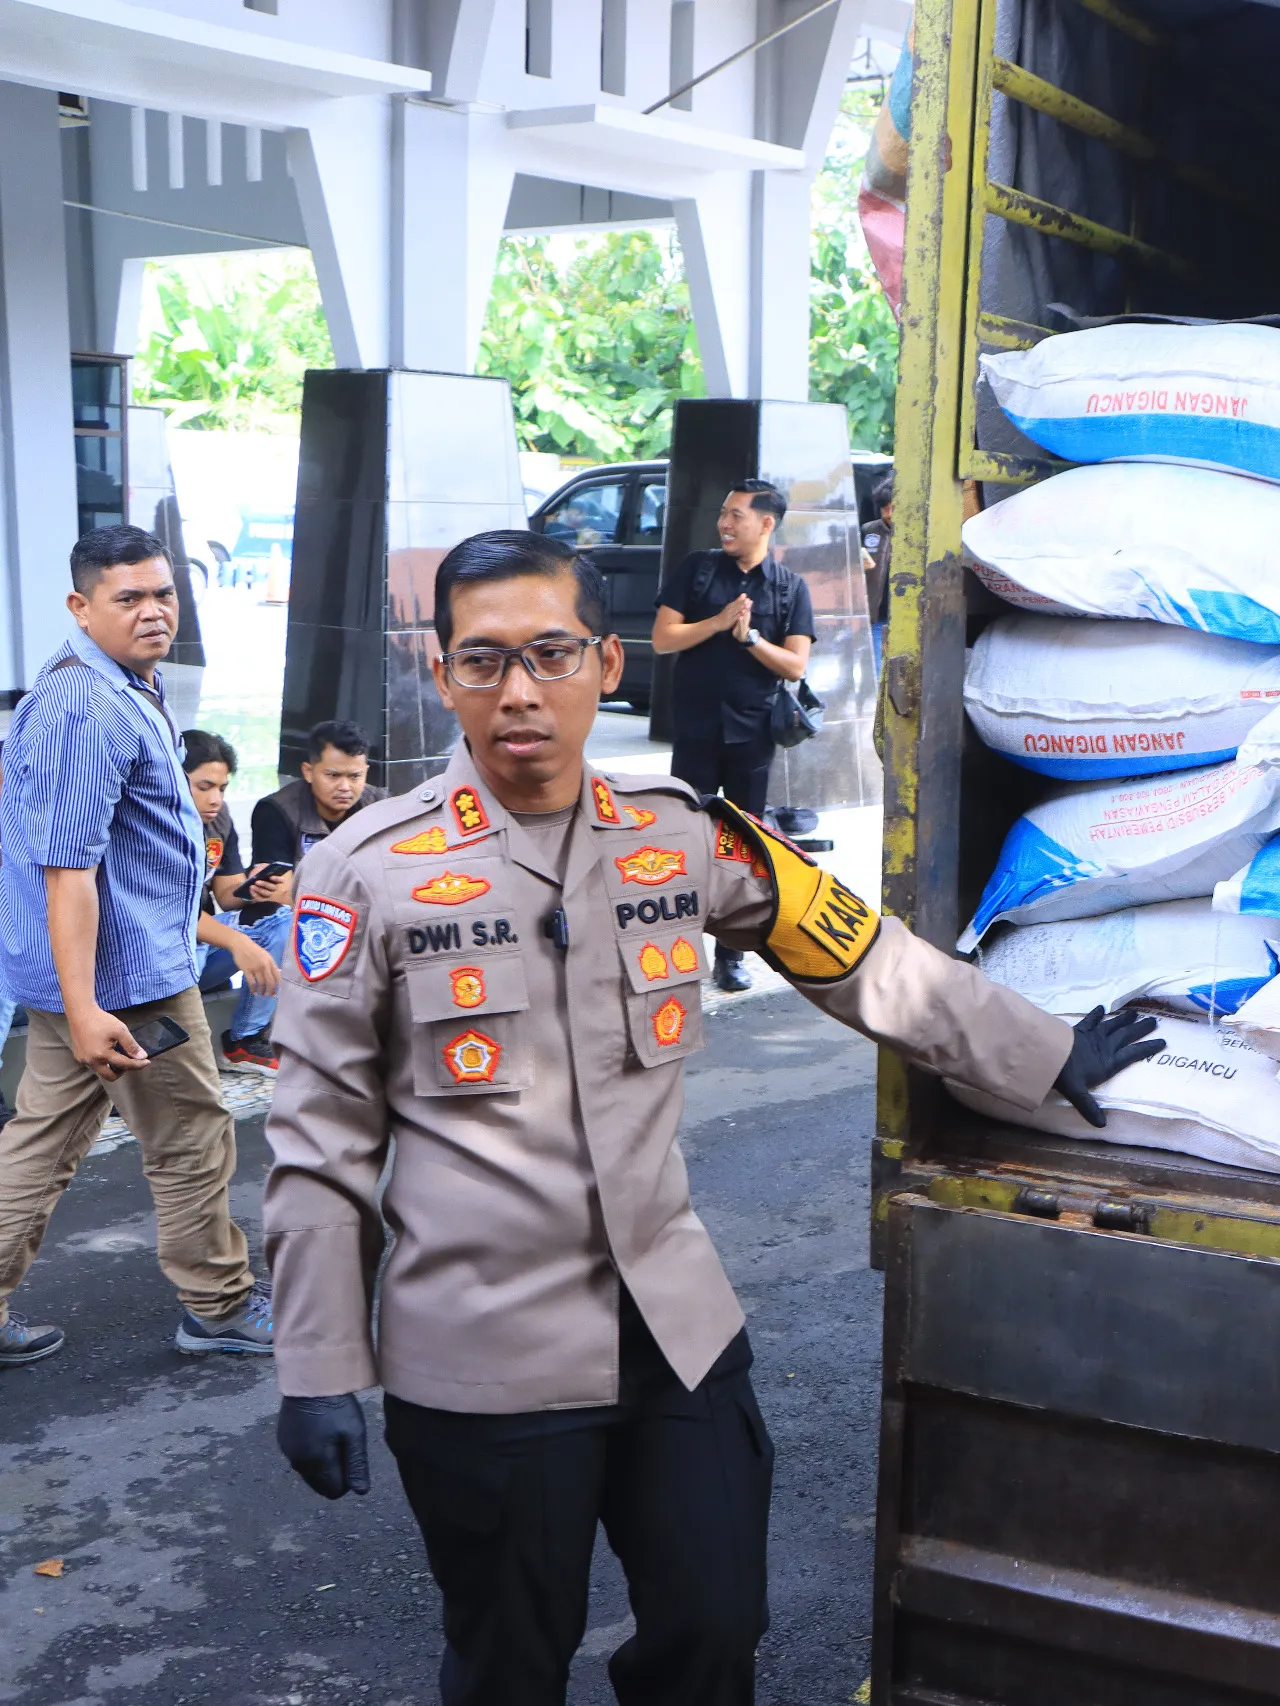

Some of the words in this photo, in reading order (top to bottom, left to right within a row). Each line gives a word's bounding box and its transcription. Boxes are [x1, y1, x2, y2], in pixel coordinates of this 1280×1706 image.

[1086, 391, 1168, 414] DIGANCU
[1174, 394, 1249, 417] JANGAN
[1024, 733, 1109, 753] DIGANCU
[1113, 732, 1186, 752] JANGAN
[1089, 821, 1164, 841] PEMERINTAH
[616, 891, 699, 930] POLRI
[408, 922, 461, 954] DWI
[472, 918, 519, 947] S.R.
[1156, 1053, 1239, 1081] DIGANCU
